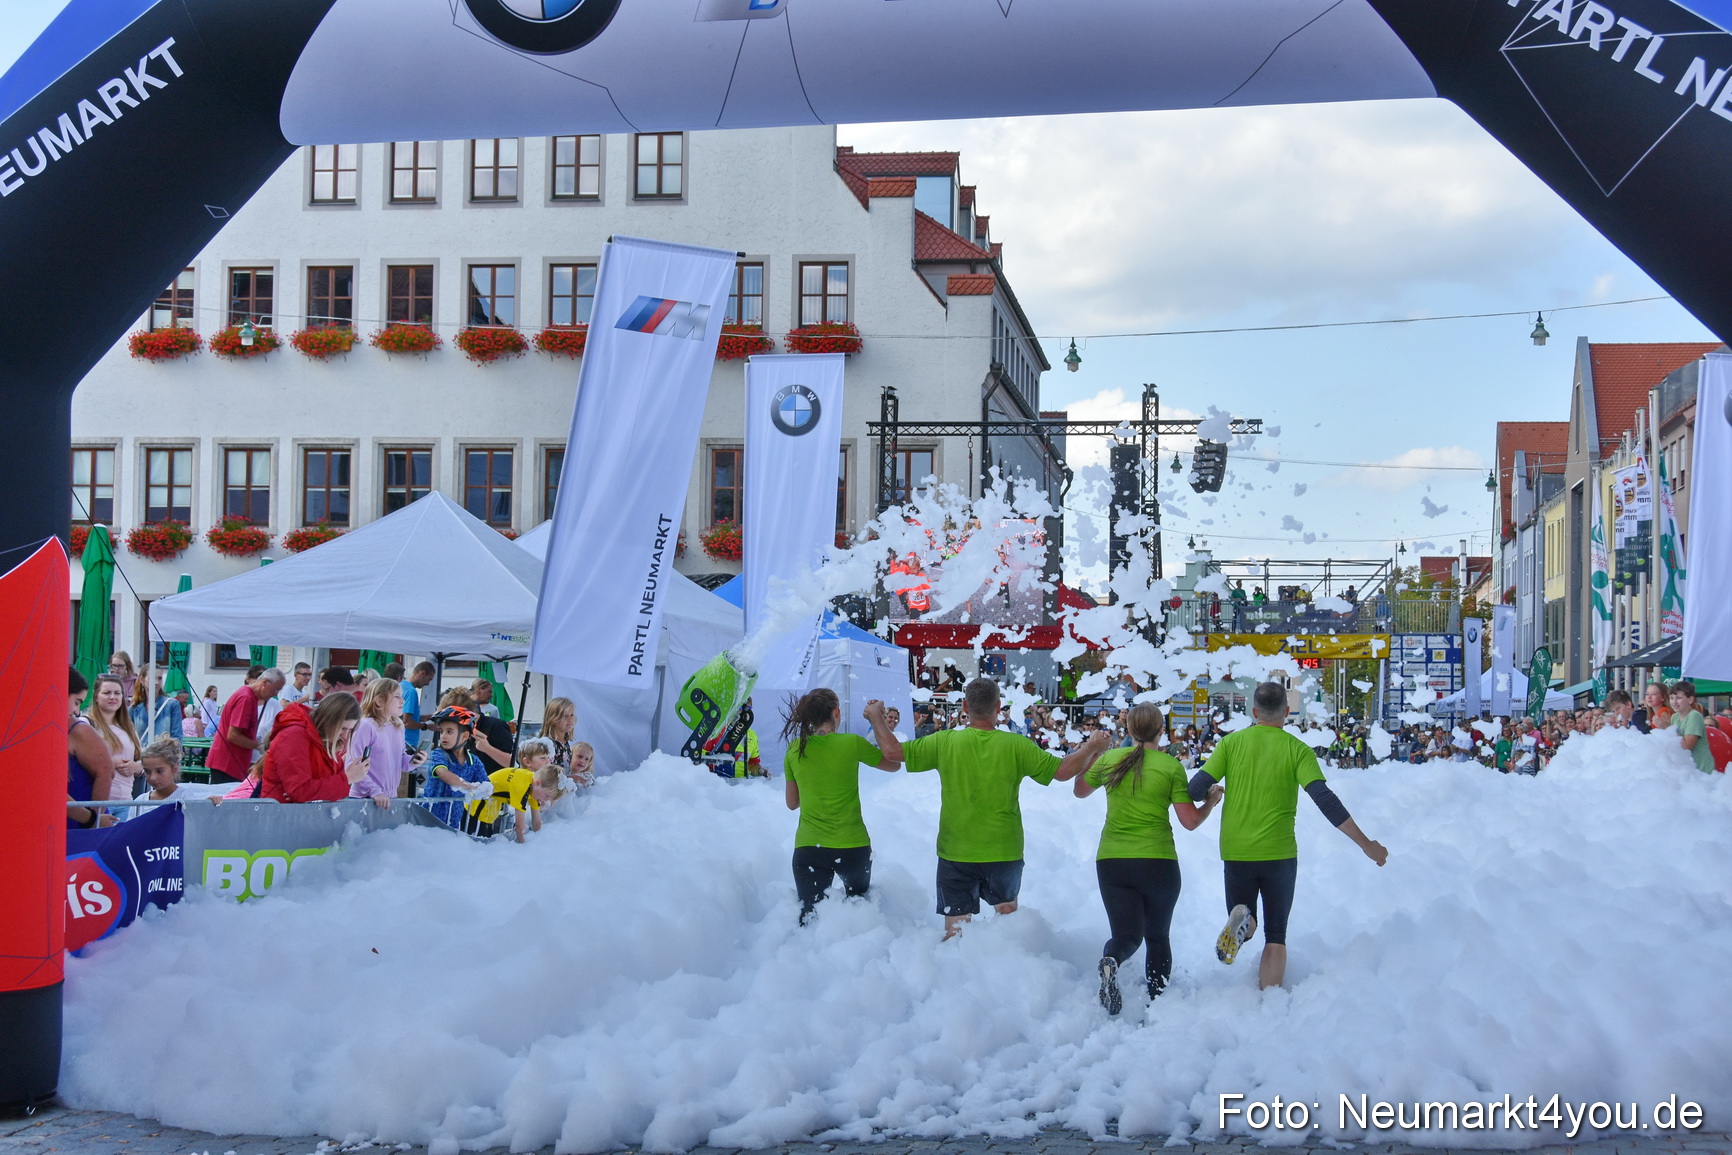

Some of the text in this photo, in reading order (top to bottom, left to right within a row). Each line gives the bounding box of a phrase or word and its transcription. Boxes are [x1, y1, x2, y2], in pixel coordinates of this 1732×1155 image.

[1507, 0, 1665, 84] ARTL
[776, 386, 817, 402] BMW
[628, 513, 673, 676] PARTL NEUMARKT
[144, 846, 180, 862] STORE
[148, 877, 183, 893] ONLINE
[205, 856, 318, 897] BO
